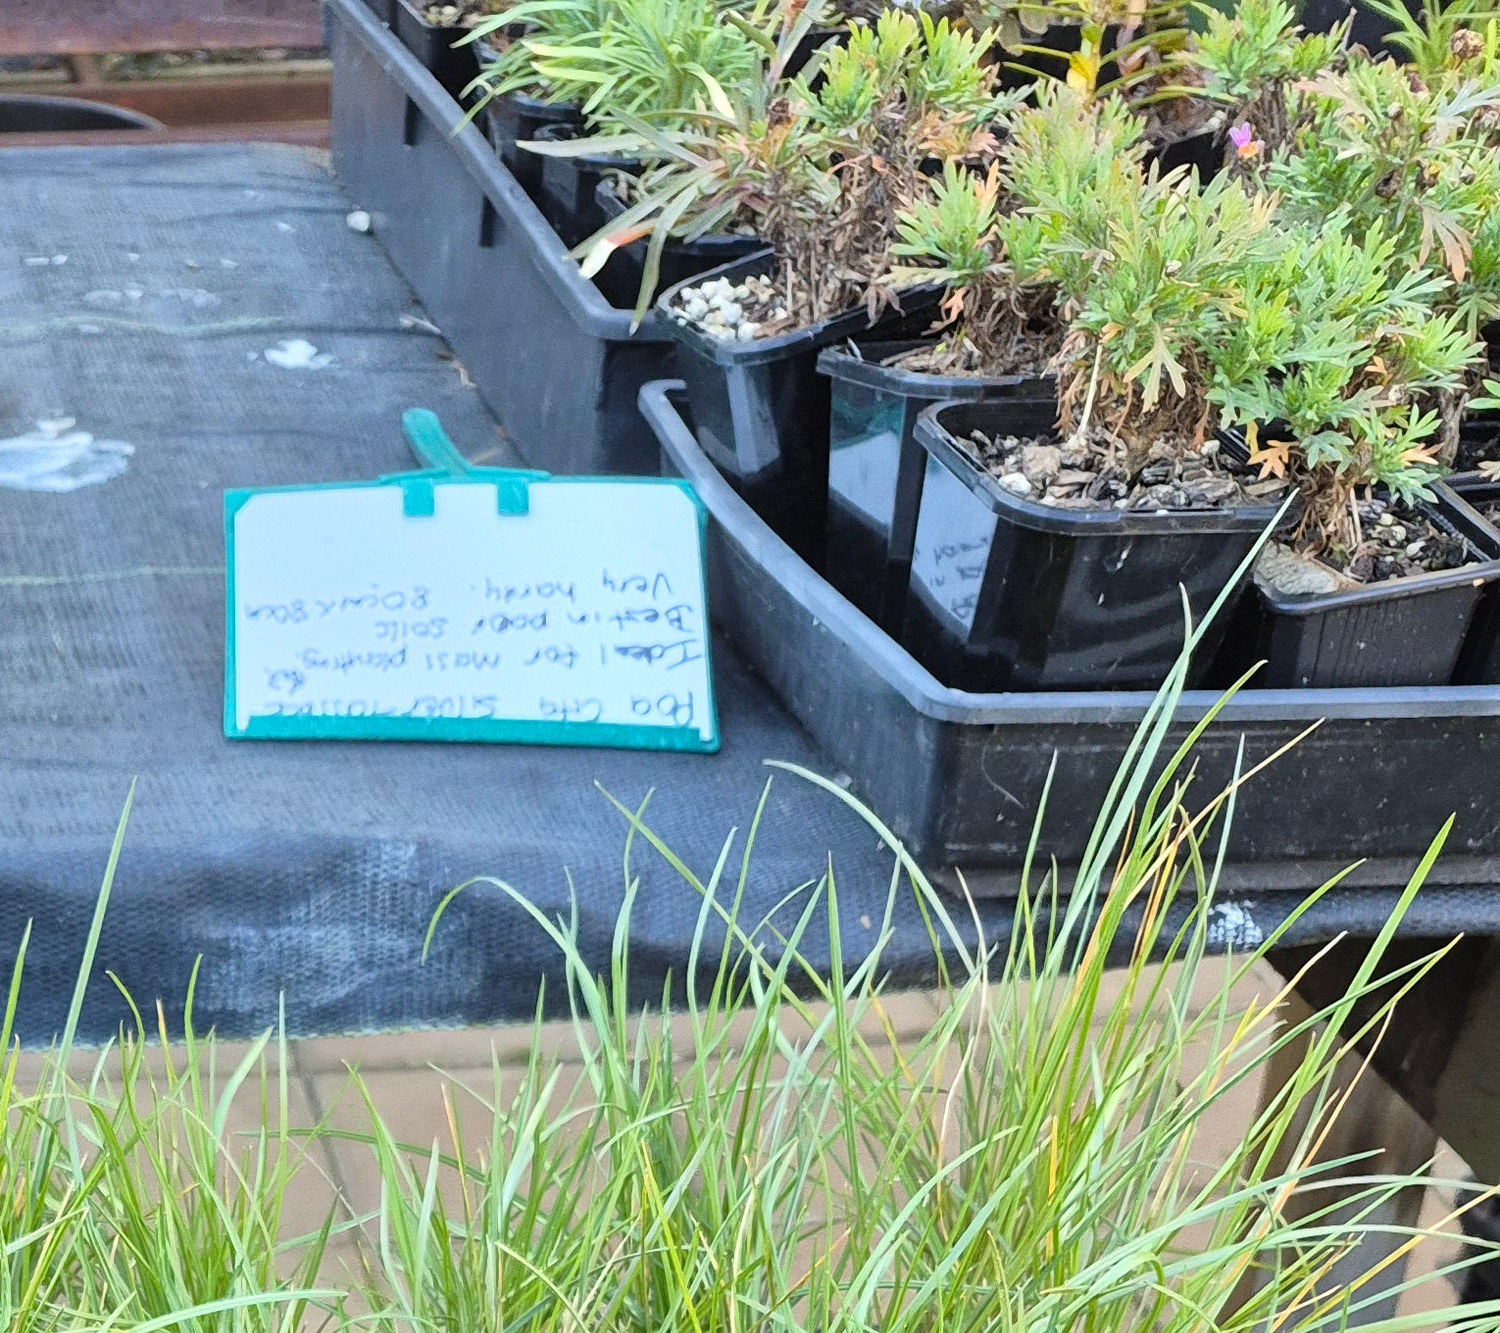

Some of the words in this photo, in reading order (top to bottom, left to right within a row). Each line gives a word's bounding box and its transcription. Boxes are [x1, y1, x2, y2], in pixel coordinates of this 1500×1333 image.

[602, 566, 673, 601] Very
[471, 609, 547, 636] poor
[523, 641, 578, 671] for
[601, 639, 701, 671] Ideal
